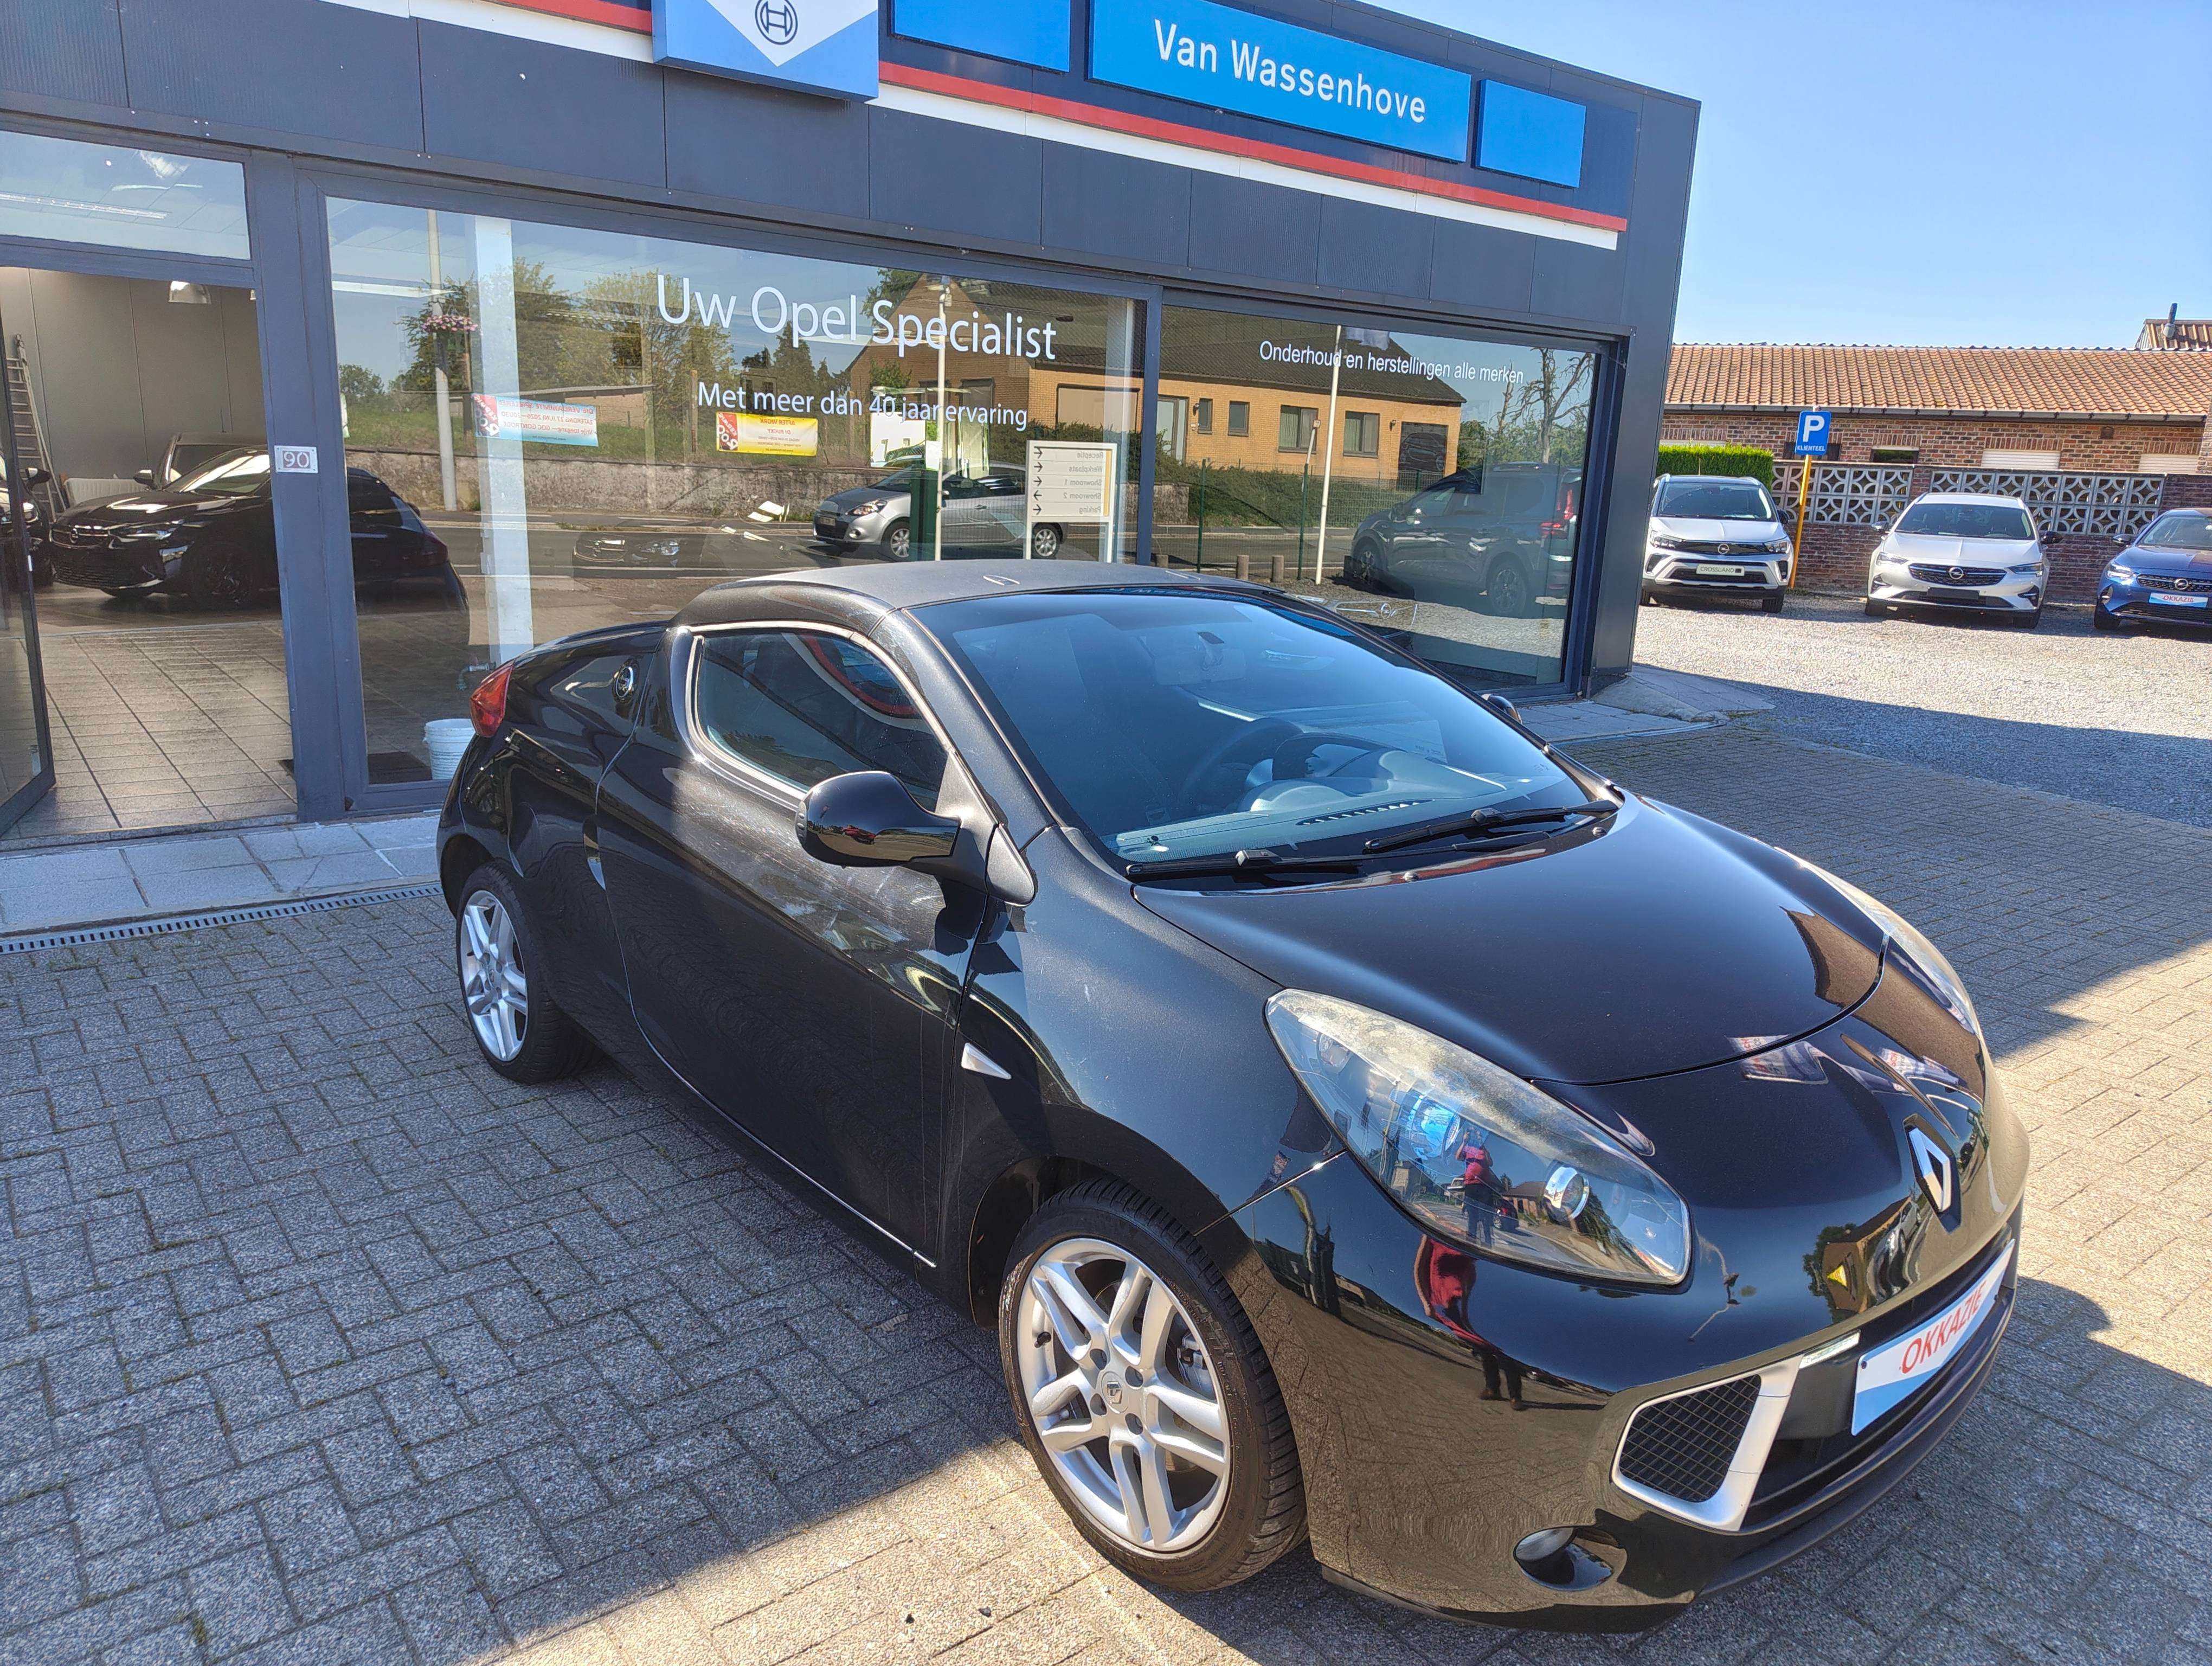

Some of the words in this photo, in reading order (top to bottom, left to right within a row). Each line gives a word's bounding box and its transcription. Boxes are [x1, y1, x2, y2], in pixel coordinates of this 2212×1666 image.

[1154, 19, 1218, 73] Van
[1231, 39, 1426, 124] Wassenhove
[657, 274, 737, 328] Uw
[751, 285, 857, 348] Opel
[872, 300, 1057, 360] Specialist
[1259, 340, 1342, 368] Onderhoud
[1346, 354, 1363, 369] en
[1367, 351, 1450, 380] herstellingen
[1454, 362, 1475, 380] alle
[1480, 367, 1523, 384] merken
[698, 381, 747, 411] Met
[753, 392, 813, 413] meer
[820, 391, 863, 416] dan
[869, 395, 896, 417] 40
[900, 397, 941, 424] jaar
[946, 403, 1028, 431] ervaring
[1803, 415, 1824, 442] P
[284, 451, 309, 468] 90
[1900, 1280, 1986, 1374] OKKAZIE
